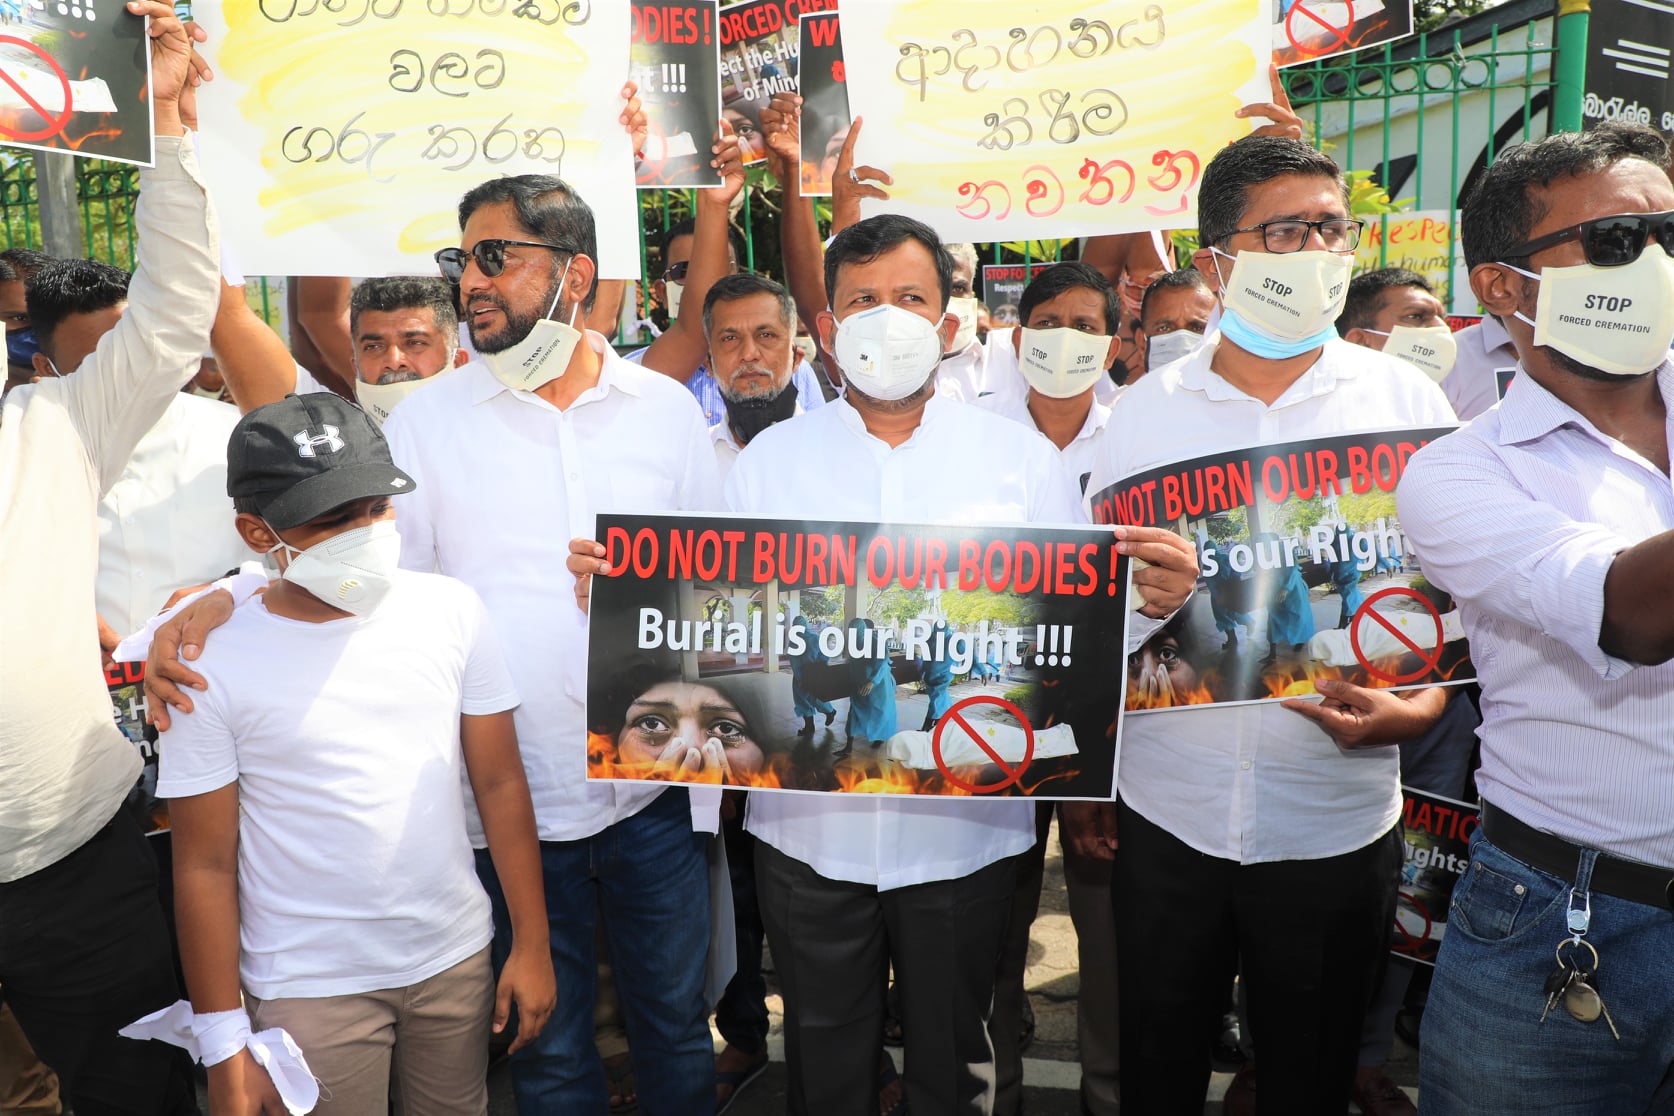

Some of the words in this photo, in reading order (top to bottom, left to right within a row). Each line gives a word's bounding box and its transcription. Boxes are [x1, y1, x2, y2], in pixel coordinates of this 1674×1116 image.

[744, 48, 774, 69] the
[388, 48, 507, 98] වලට
[743, 80, 761, 102] of
[986, 268, 1009, 281] STOP
[1262, 277, 1293, 298] STOP
[1244, 287, 1266, 302] FORCED
[1266, 297, 1301, 318] CREMATION
[1585, 294, 1632, 313] STOP
[1559, 314, 1592, 327] FORCED
[1595, 320, 1651, 334] CREMATION
[522, 345, 543, 368] STOP
[1032, 346, 1048, 361] STOP
[1076, 354, 1095, 365] STOP
[1411, 344, 1436, 357] STOP
[1114, 480, 1157, 526] NOT
[1162, 460, 1254, 521] BURN
[1261, 450, 1343, 503] OUR
[606, 527, 660, 579] DO
[668, 529, 746, 582] NOT
[753, 532, 857, 586] BURN
[866, 535, 948, 590] OUR
[958, 539, 1098, 597] BODIES
[1229, 538, 1299, 574] our
[638, 607, 762, 654] Burial
[775, 612, 807, 656] is
[818, 624, 894, 659] our
[905, 618, 1024, 674] Right
[1034, 624, 1073, 668] !!!
